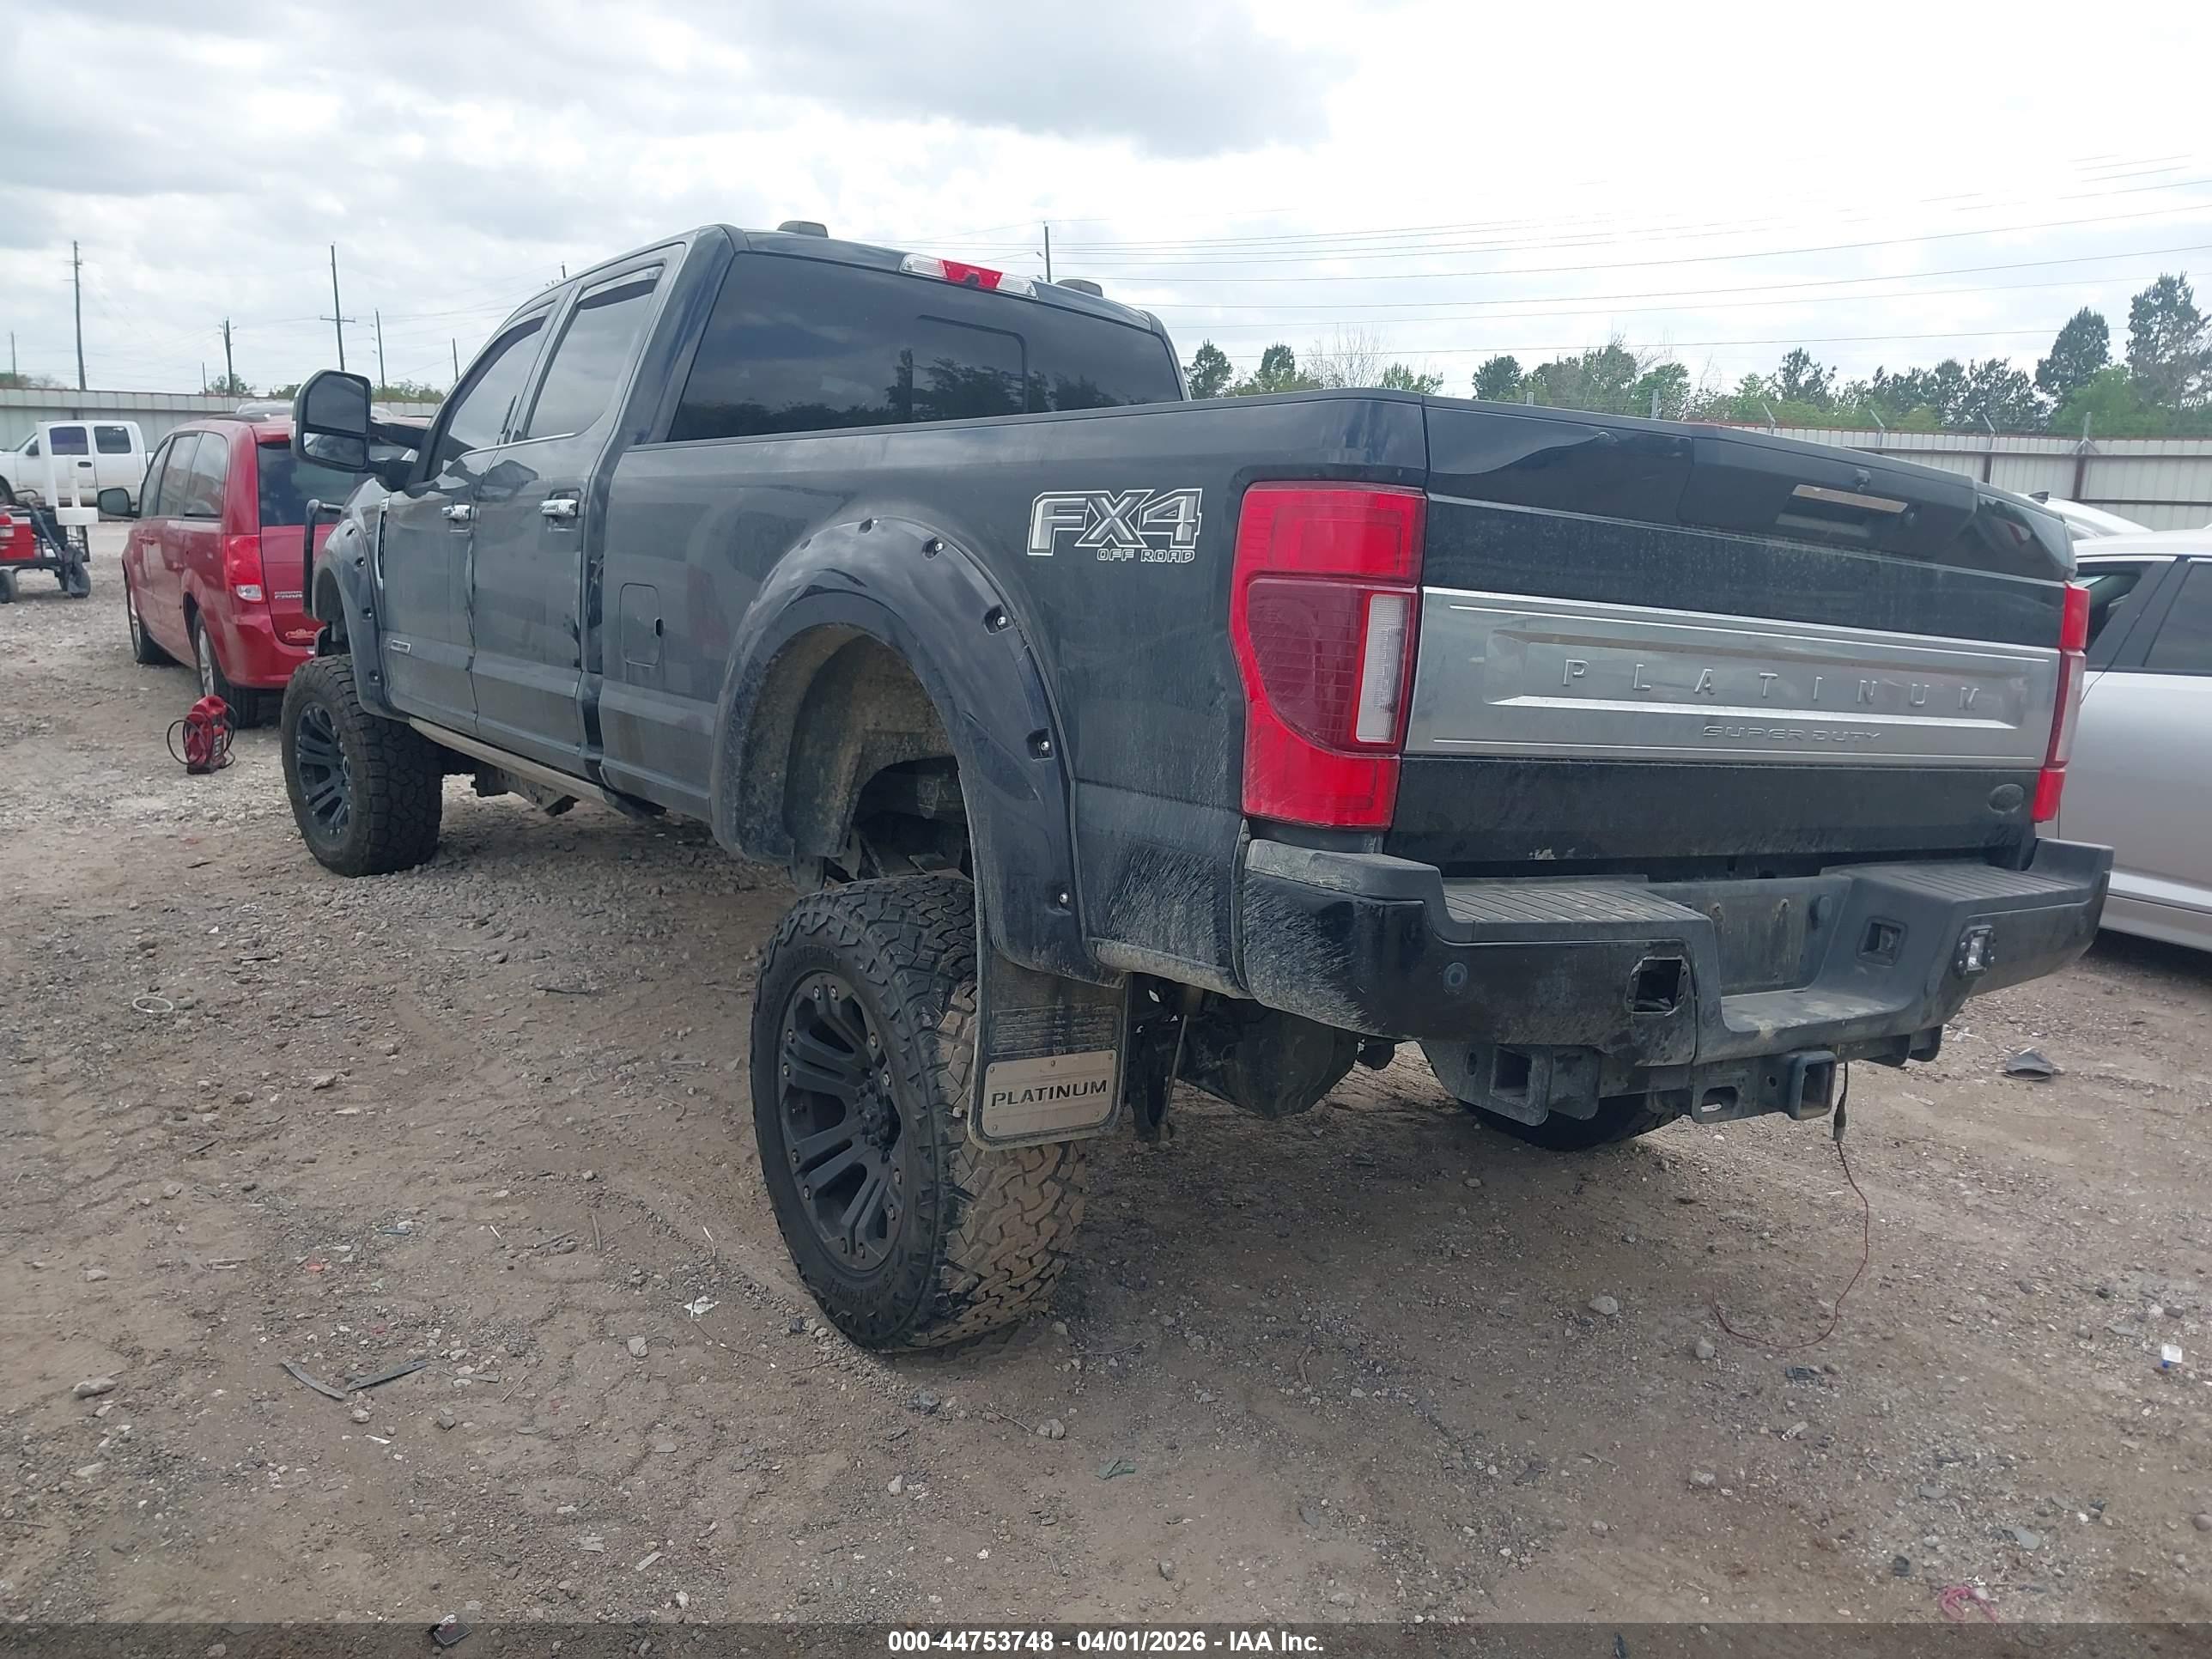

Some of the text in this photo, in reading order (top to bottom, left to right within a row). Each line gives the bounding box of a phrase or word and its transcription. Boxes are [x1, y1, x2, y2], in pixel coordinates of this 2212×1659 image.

[1027, 489, 1202, 556] FX4
[1097, 548, 1195, 563] OFF ROAD
[1562, 659, 1980, 711] PLATINUM
[1703, 725, 1881, 742] SUPER DUTY
[991, 1079, 1108, 1107] PLATINUM
